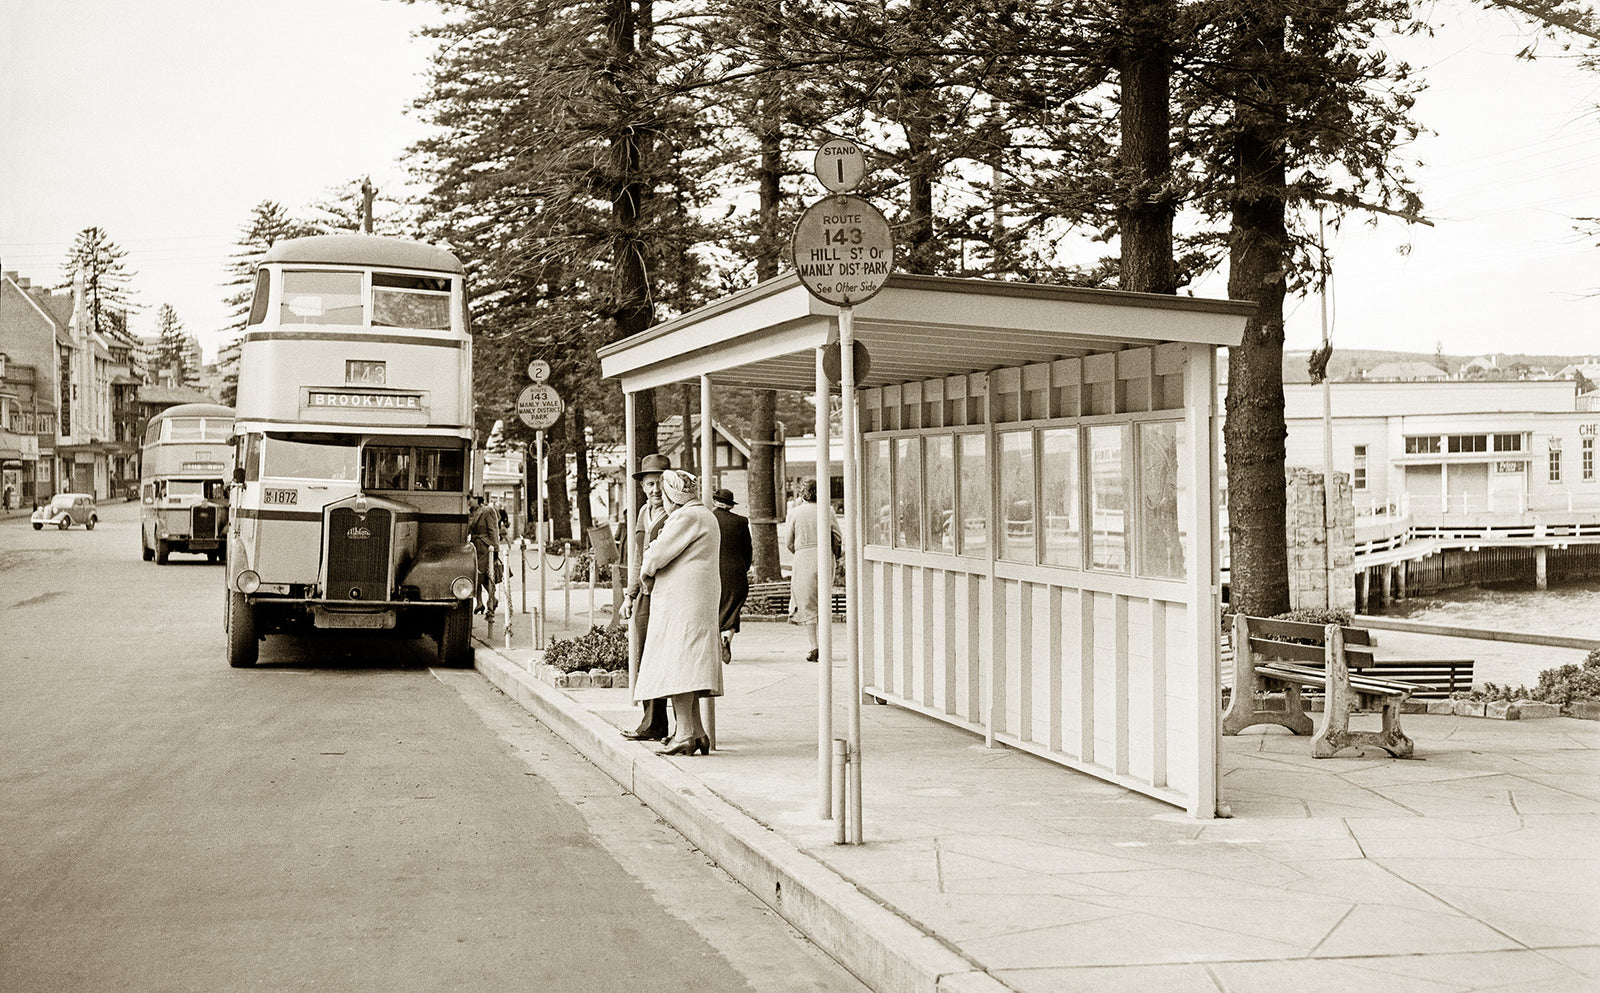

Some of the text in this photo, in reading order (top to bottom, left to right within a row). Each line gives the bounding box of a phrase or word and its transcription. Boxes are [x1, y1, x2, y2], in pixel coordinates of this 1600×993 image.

[824, 146, 856, 156] STAND
[823, 214, 862, 225] ROUTE
[824, 228, 863, 246] 143
[810, 248, 841, 261] HILL
[869, 246, 884, 260] Or
[800, 264, 834, 277] MANLY
[864, 261, 889, 275] PARK
[816, 280, 877, 294] See Other Side
[350, 362, 385, 384] 143
[535, 368, 543, 379] 2
[315, 393, 417, 408] BROOKVALE
[531, 393, 548, 401] 143
[274, 491, 297, 504] 1872
